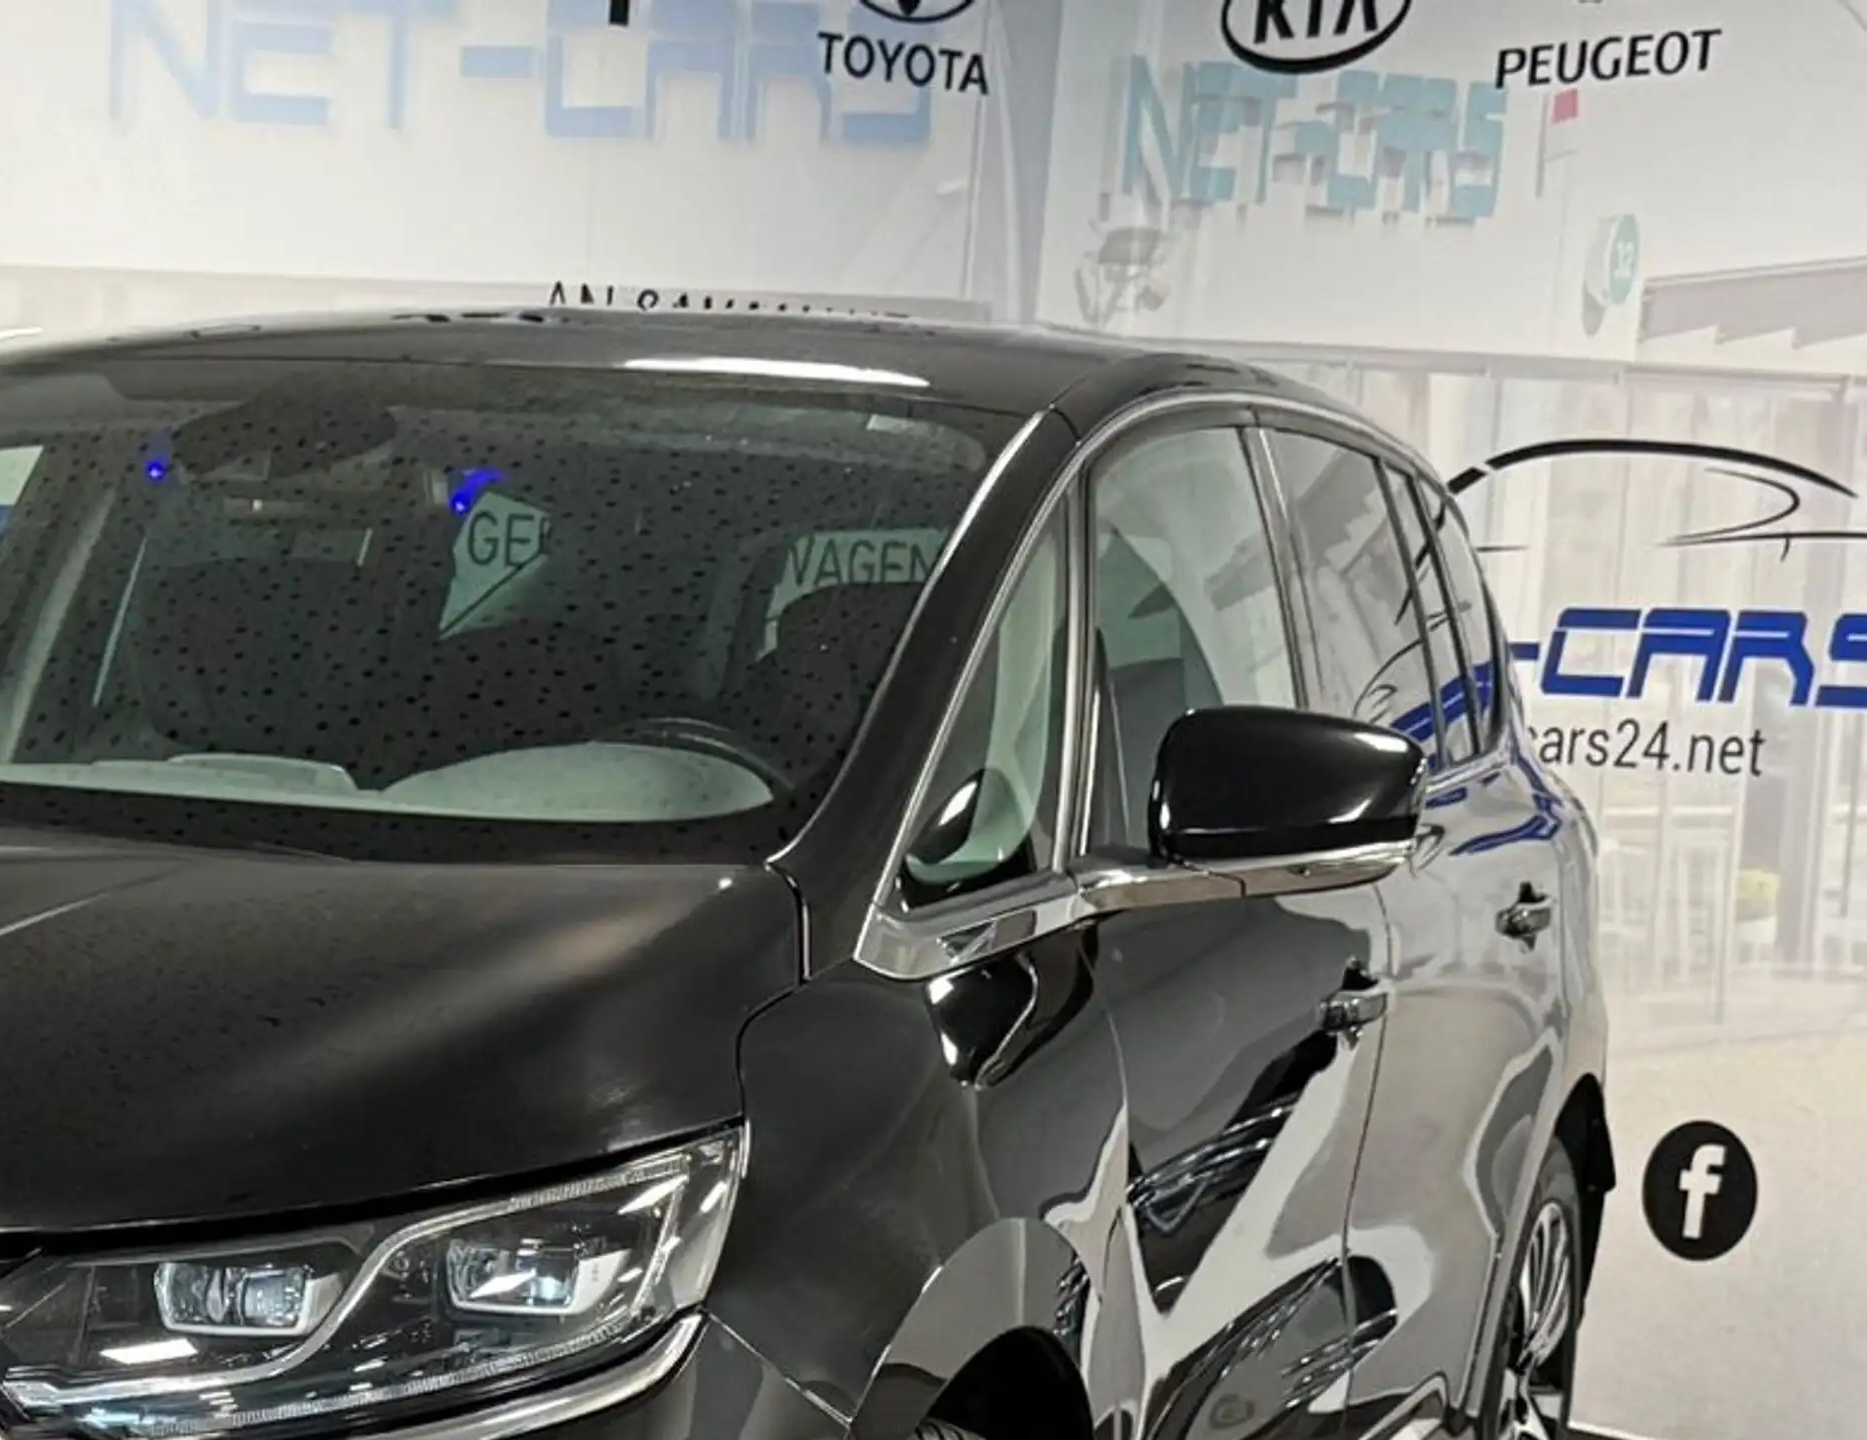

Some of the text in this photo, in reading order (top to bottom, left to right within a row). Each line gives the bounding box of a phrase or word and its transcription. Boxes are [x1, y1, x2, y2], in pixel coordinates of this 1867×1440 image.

[818, 31, 989, 96] TOYOTA
[1495, 28, 1722, 89] PEUGEOT
[1527, 718, 1766, 777] ars24.net
